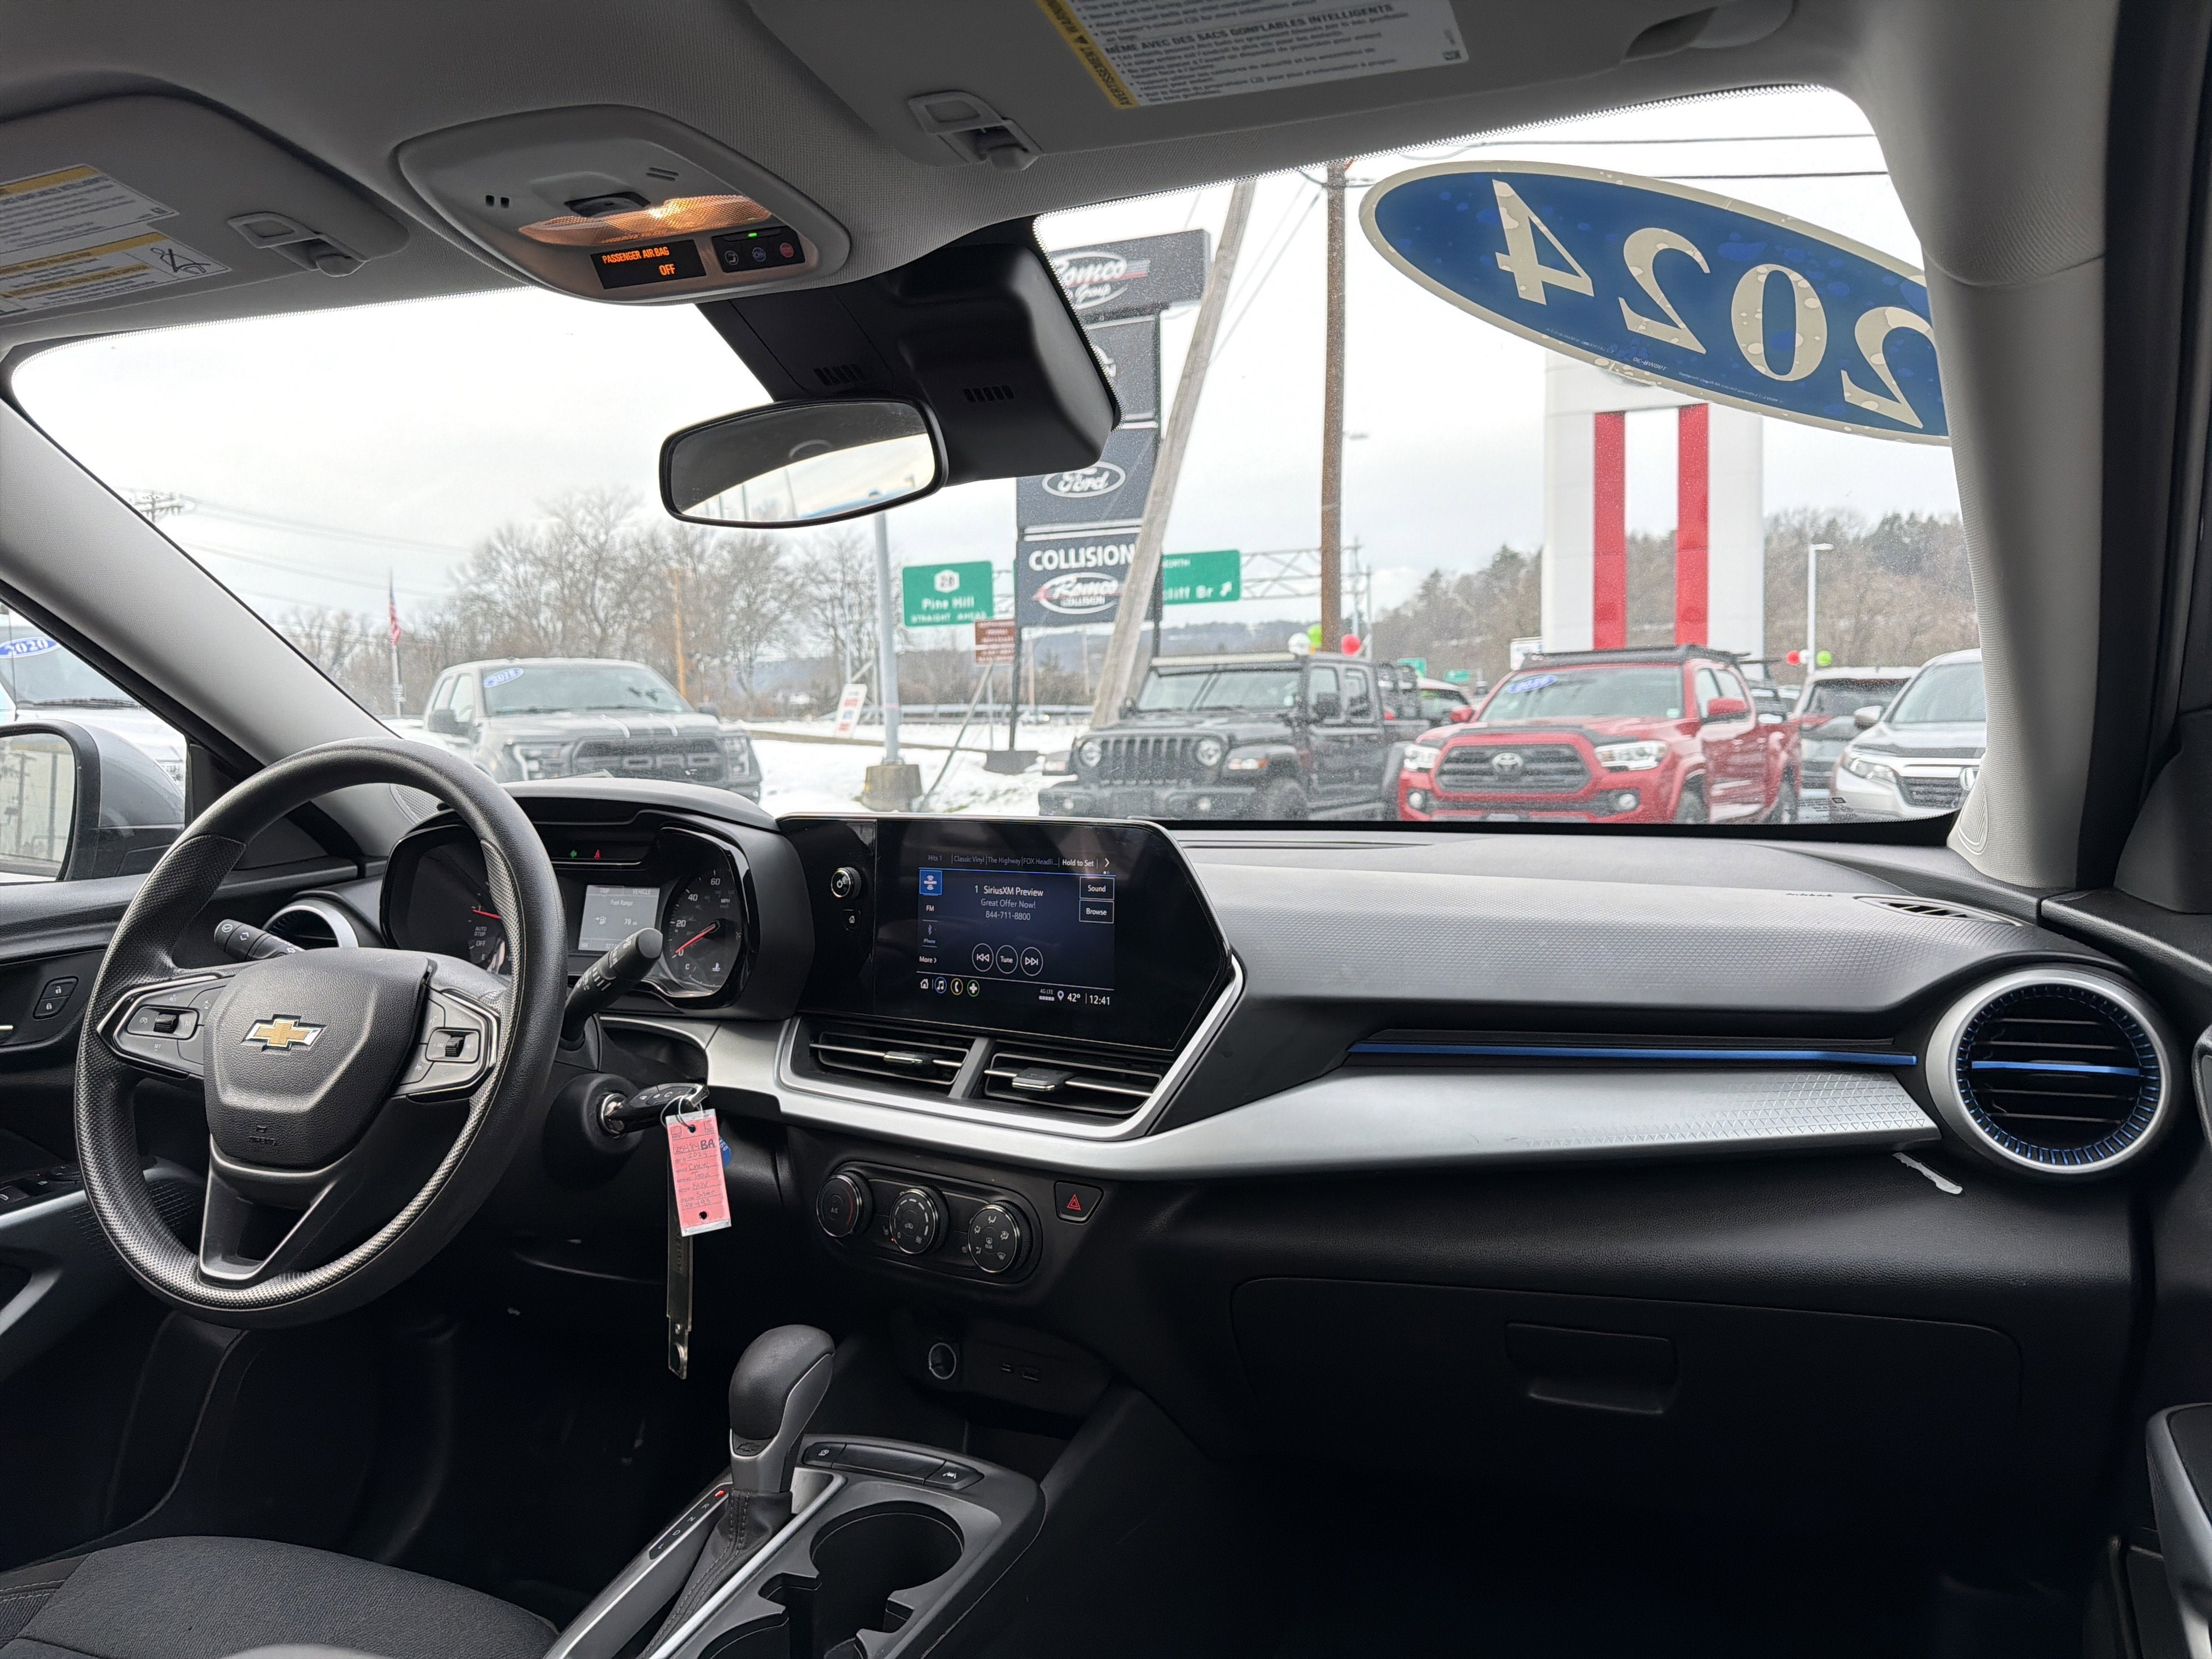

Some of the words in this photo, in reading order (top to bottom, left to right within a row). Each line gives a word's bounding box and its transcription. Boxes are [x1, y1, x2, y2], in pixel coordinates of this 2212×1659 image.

[1141, 39, 1170, 48] AVEC
[1172, 35, 1195, 44] DES
[602, 250, 642, 264] PASSENGER
[642, 249, 654, 259] AIR
[654, 246, 670, 257] BAG
[659, 264, 676, 276] OFF
[1057, 466, 1110, 493] Ford
[1028, 543, 1136, 571] COLLISION
[1195, 584, 1215, 599] Br
[922, 597, 949, 610] Pine
[951, 595, 975, 608] Hill
[910, 612, 951, 624] STRAIGHT
[4, 638, 49, 657] 2020
[954, 855, 972, 863] Classic
[973, 856, 985, 865] Vinyl
[710, 877, 721, 885] 60
[974, 885, 979, 894] 1
[983, 885, 1014, 895] SiriusXM
[1015, 887, 1044, 897] Preview
[1087, 884, 1107, 893] Sound
[687, 893, 698, 901] 40
[980, 898, 998, 907] Great
[1000, 899, 1017, 908] Offer
[1018, 900, 1036, 909] Now!
[985, 910, 1031, 921] 844-711-8800
[1086, 907, 1108, 916] Browse
[1000, 955, 1013, 963] Tune
[1089, 995, 1110, 1006] 12:41
